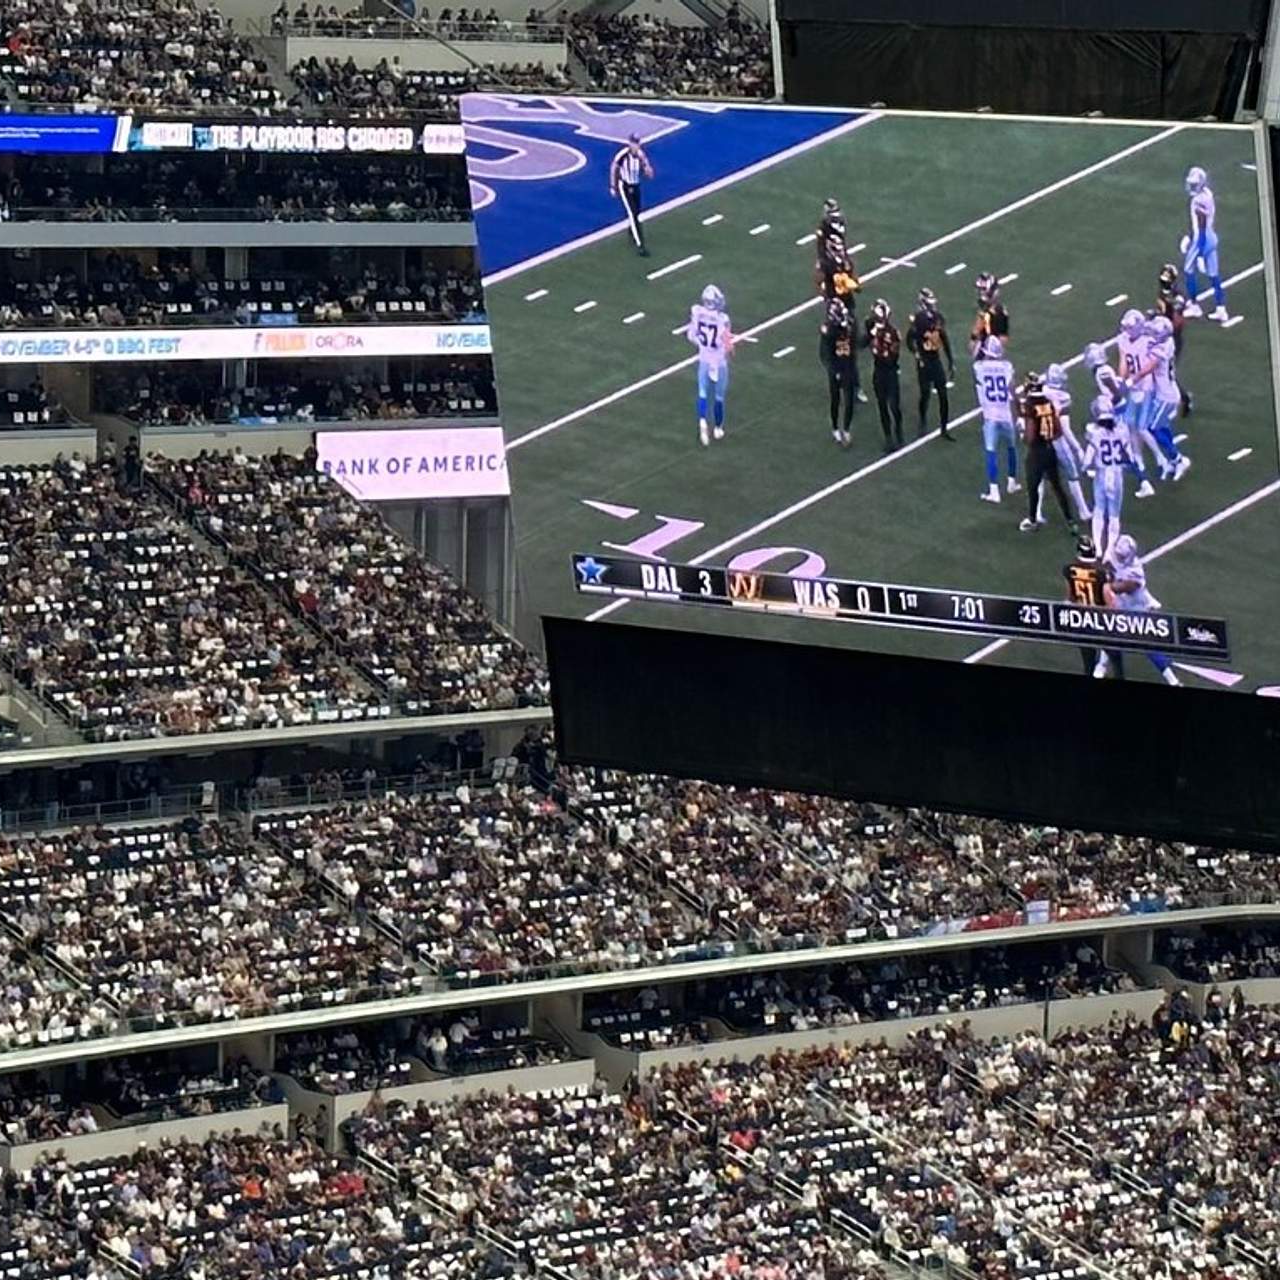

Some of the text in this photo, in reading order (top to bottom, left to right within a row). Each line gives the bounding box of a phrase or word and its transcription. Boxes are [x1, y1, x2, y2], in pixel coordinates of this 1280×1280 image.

[210, 125, 239, 150] THE
[104, 339, 114, 354] Q
[117, 339, 145, 354] BBQ
[148, 338, 181, 353] FEST
[323, 454, 506, 476] BANK OF AMERIC
[641, 564, 681, 593] DAL
[699, 571, 712, 596] 3
[792, 580, 840, 609] WAS
[857, 587, 870, 613] 0
[951, 596, 986, 620] 7:01
[1059, 610, 1170, 637] #DALVSWAS
